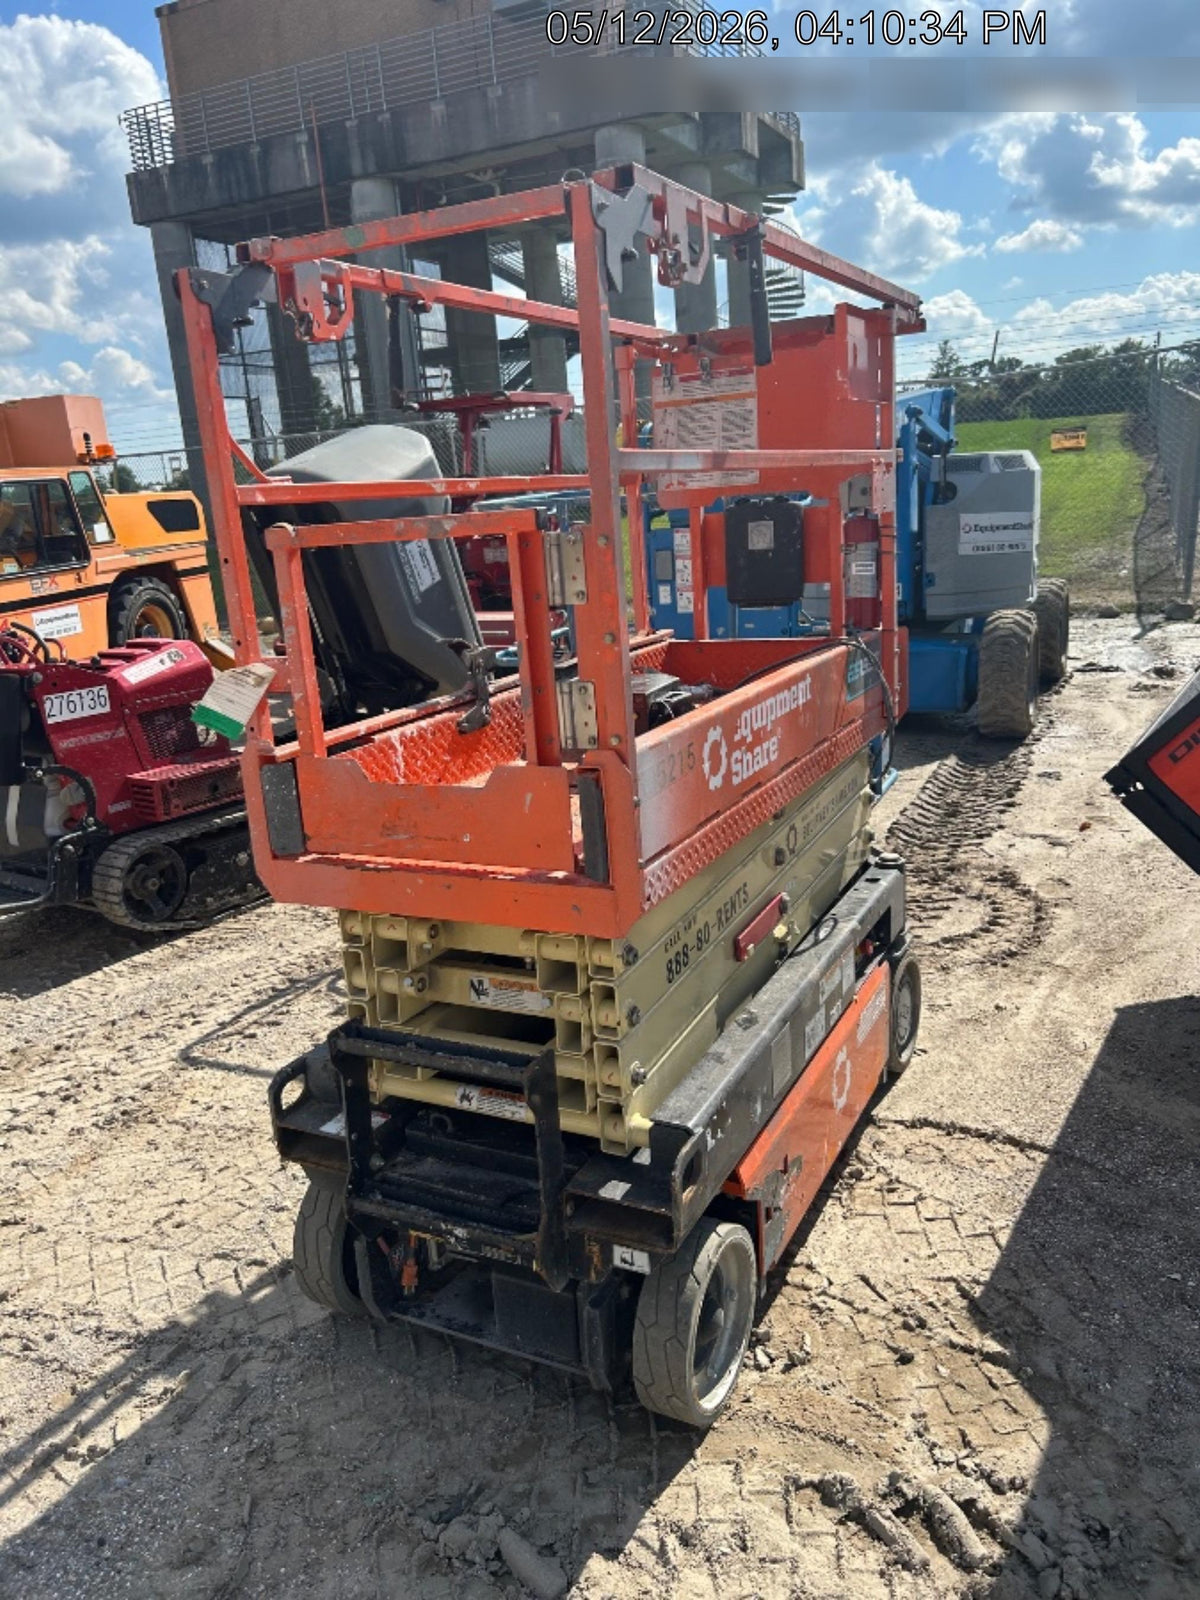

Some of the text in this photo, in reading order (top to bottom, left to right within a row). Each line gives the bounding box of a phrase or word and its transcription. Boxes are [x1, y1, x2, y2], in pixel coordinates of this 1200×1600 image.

[45, 687, 108, 719] 276136
[734, 673, 812, 743] quipment
[731, 735, 779, 786] Share
[665, 881, 749, 984] 888-80-RENTS
